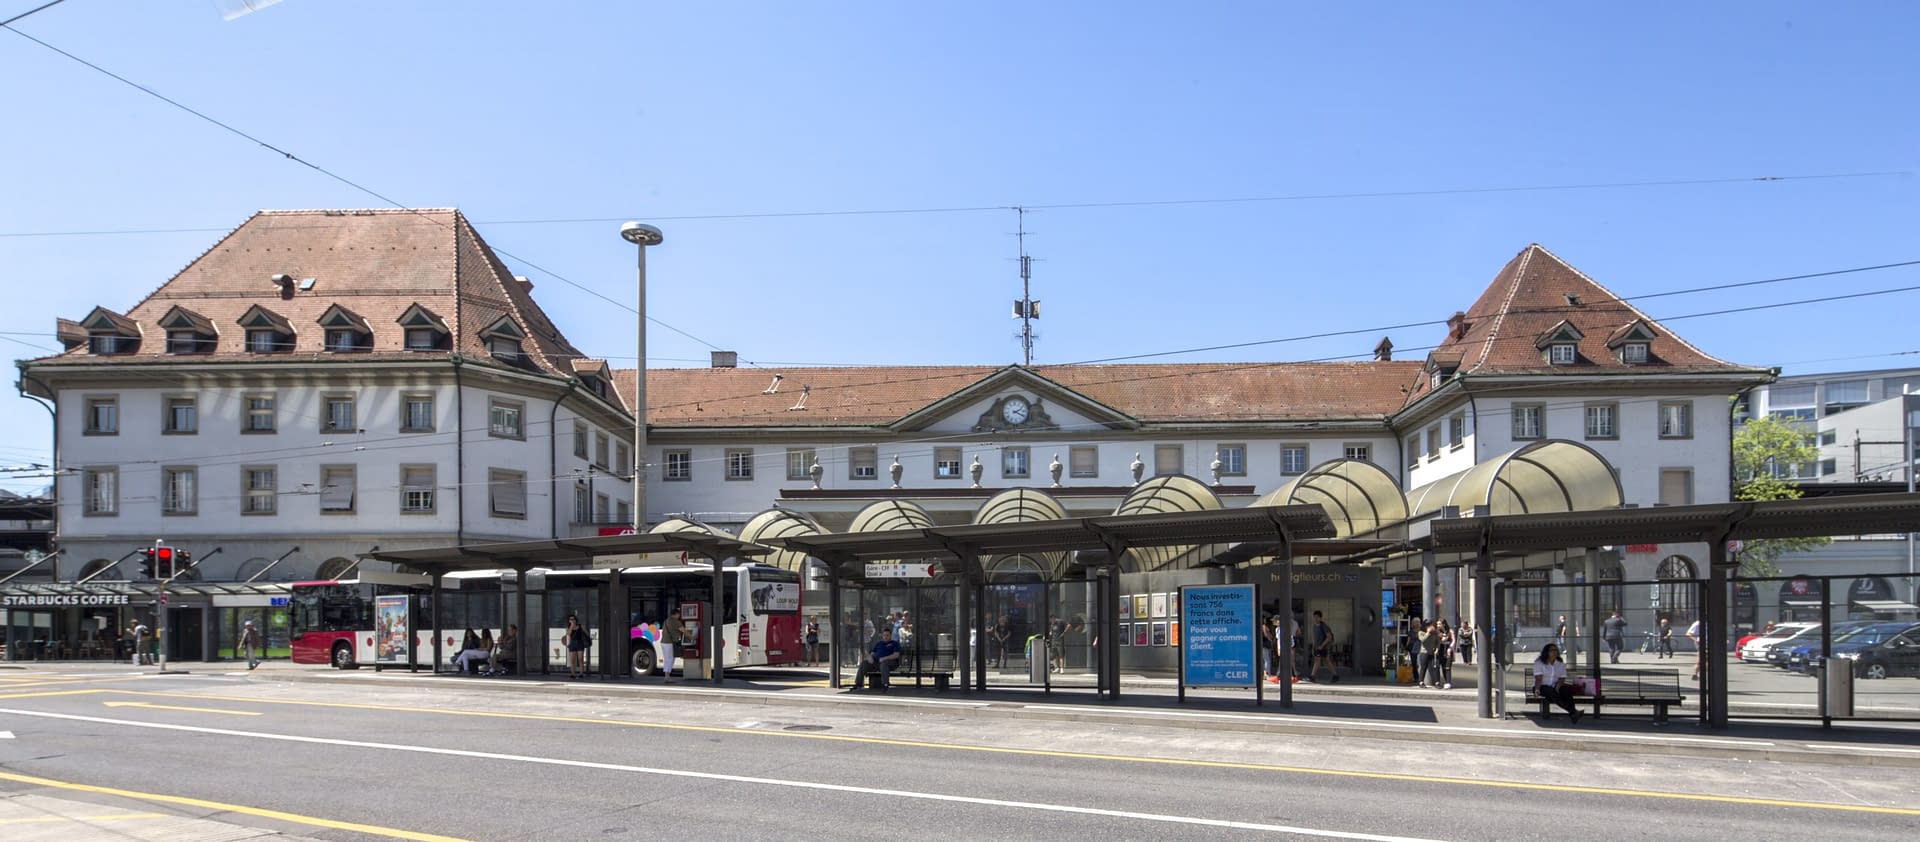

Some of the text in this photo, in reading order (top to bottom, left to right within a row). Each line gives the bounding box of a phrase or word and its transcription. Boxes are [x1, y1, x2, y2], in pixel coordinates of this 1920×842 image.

[3, 595, 129, 605] STARBUCKS COFFEE
[1211, 592, 1243, 600] investis-
[1209, 600, 1223, 608] 756
[1216, 608, 1235, 616] dans
[1212, 617, 1242, 625] affiche.
[1190, 635, 1217, 643] gagner
[1190, 642, 1214, 650] client.
[1225, 671, 1248, 679] CLER
